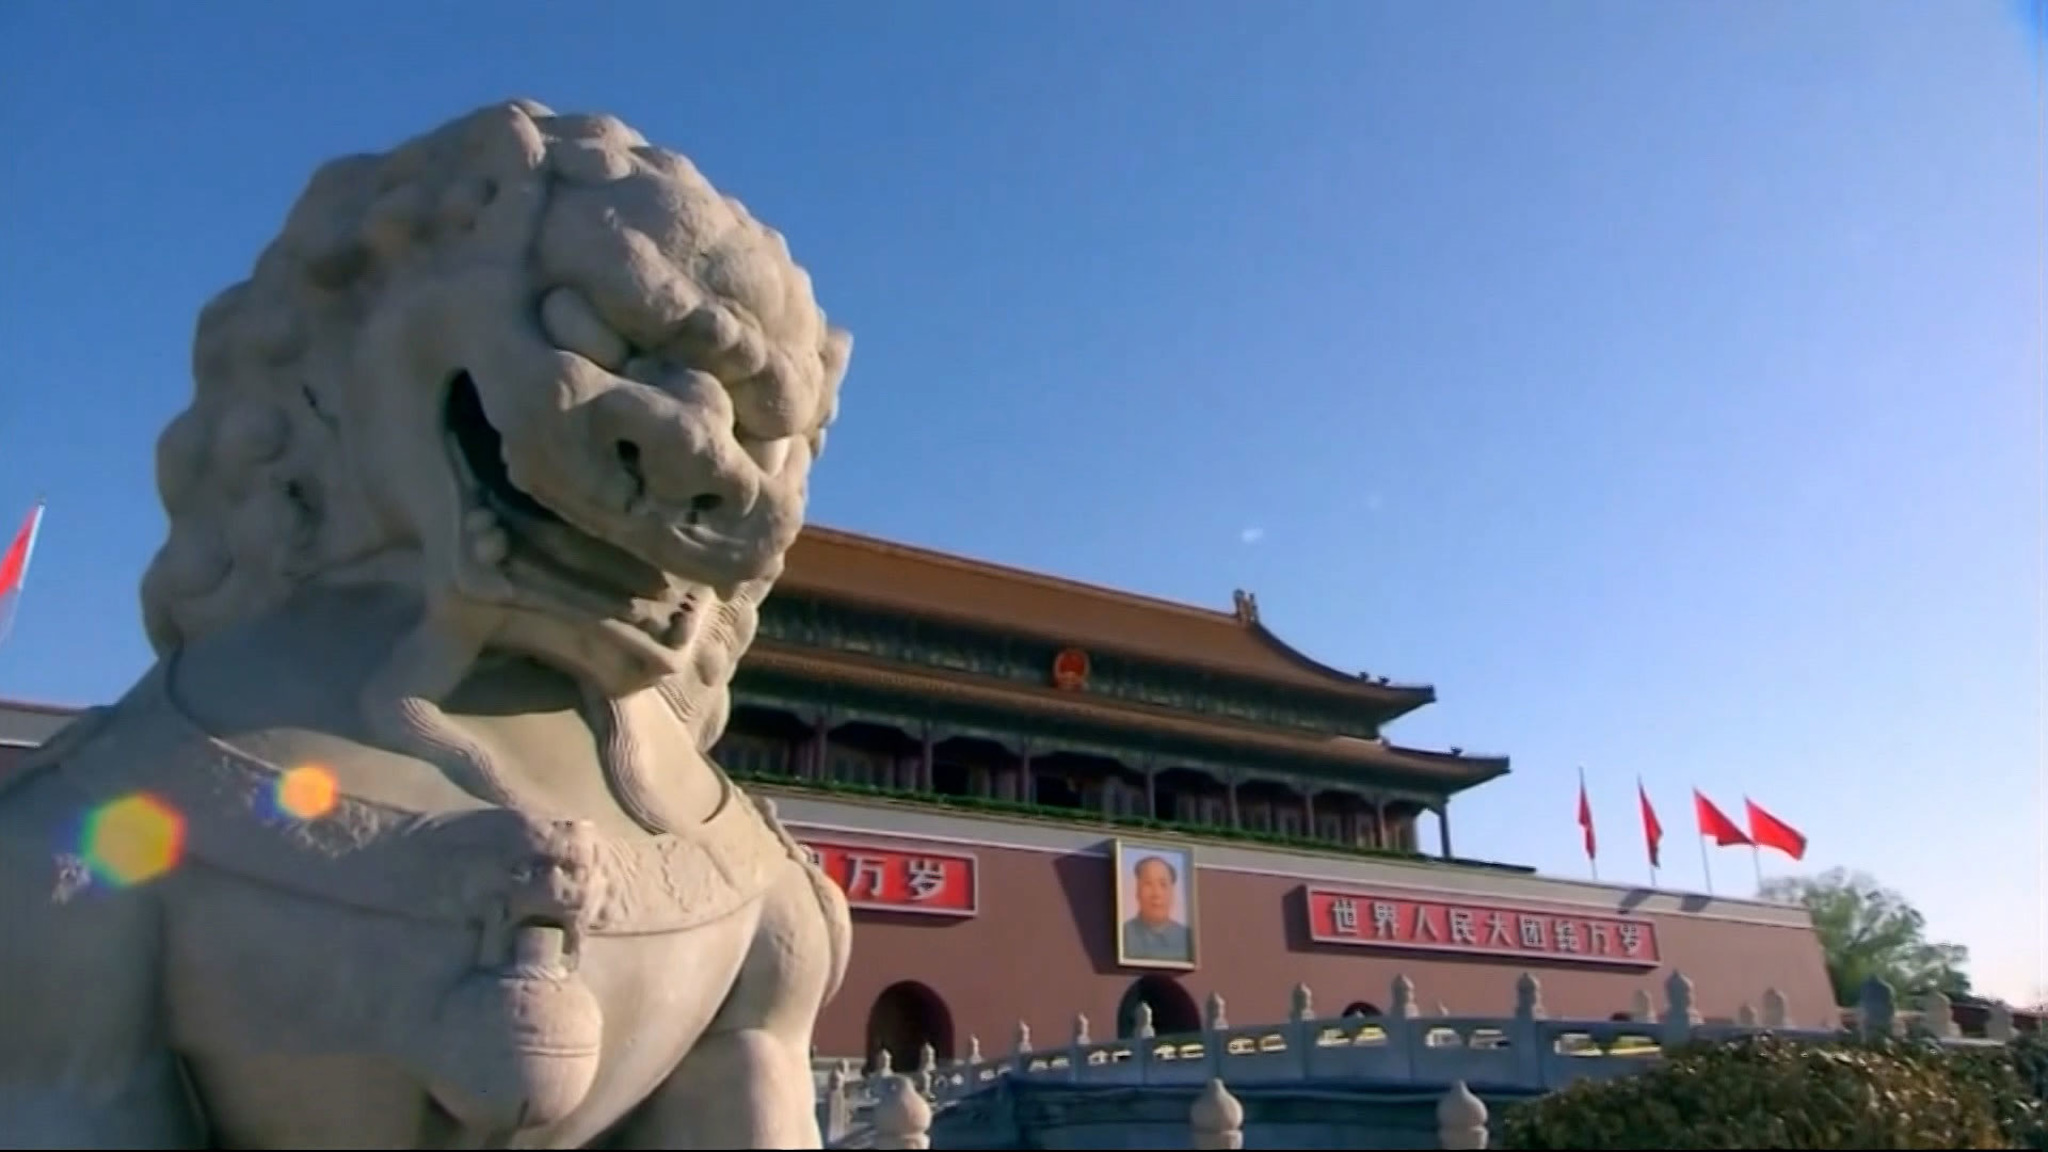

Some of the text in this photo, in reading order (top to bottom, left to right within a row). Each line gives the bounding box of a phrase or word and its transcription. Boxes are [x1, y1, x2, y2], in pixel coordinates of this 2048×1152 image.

[1332, 897, 1641, 957] 世界人民大团结万岁
